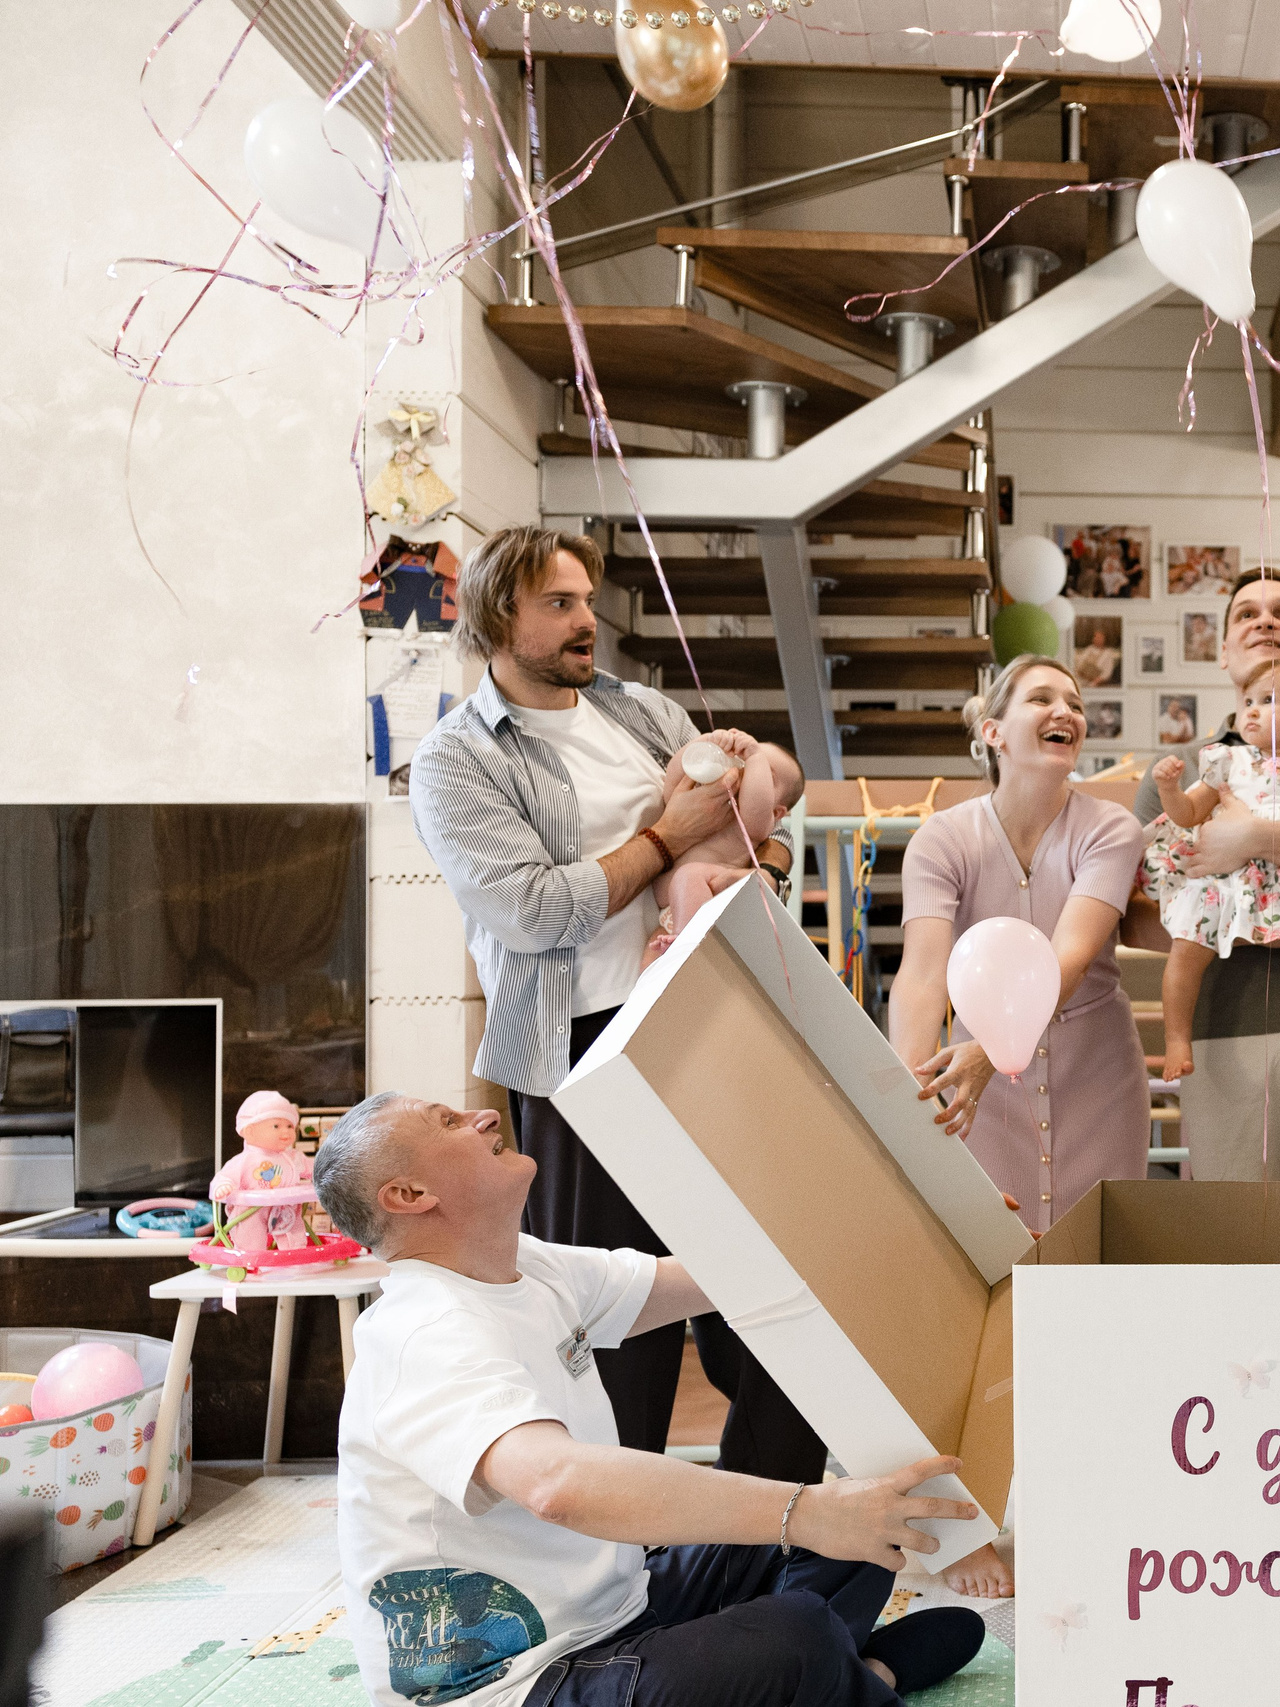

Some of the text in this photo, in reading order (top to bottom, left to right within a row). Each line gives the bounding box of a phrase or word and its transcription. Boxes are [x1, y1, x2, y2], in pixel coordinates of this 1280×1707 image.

[1171, 1396, 1220, 1475] С
[371, 1584, 446, 1611] your
[386, 1606, 456, 1649] REAL
